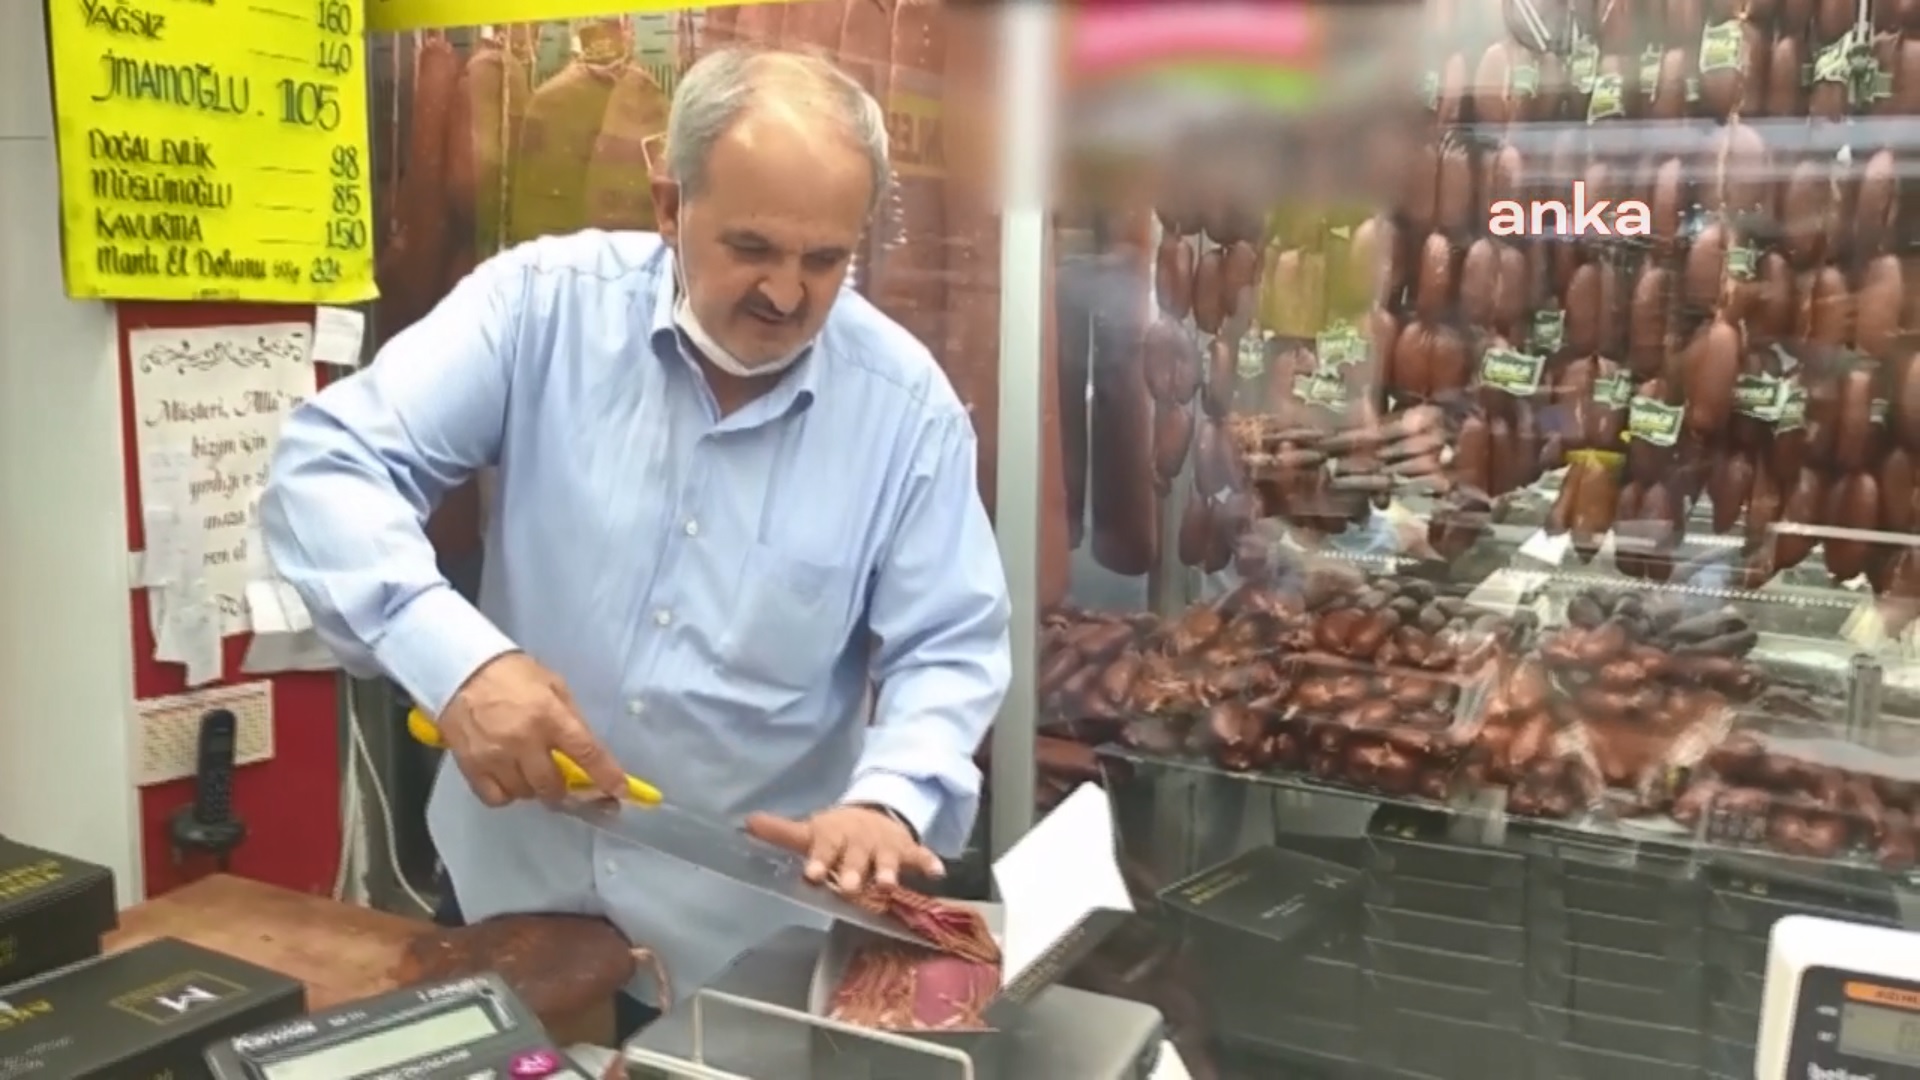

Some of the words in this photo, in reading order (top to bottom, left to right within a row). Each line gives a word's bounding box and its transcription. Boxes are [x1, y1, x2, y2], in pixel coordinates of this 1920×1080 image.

[317, 0, 352, 36] 160
[317, 41, 353, 75] 140
[275, 78, 341, 131] 105
[329, 145, 361, 181] 98
[331, 184, 362, 217] 85
[95, 206, 204, 243] KAVURMA
[325, 219, 367, 250] 150
[165, 246, 190, 277] El
